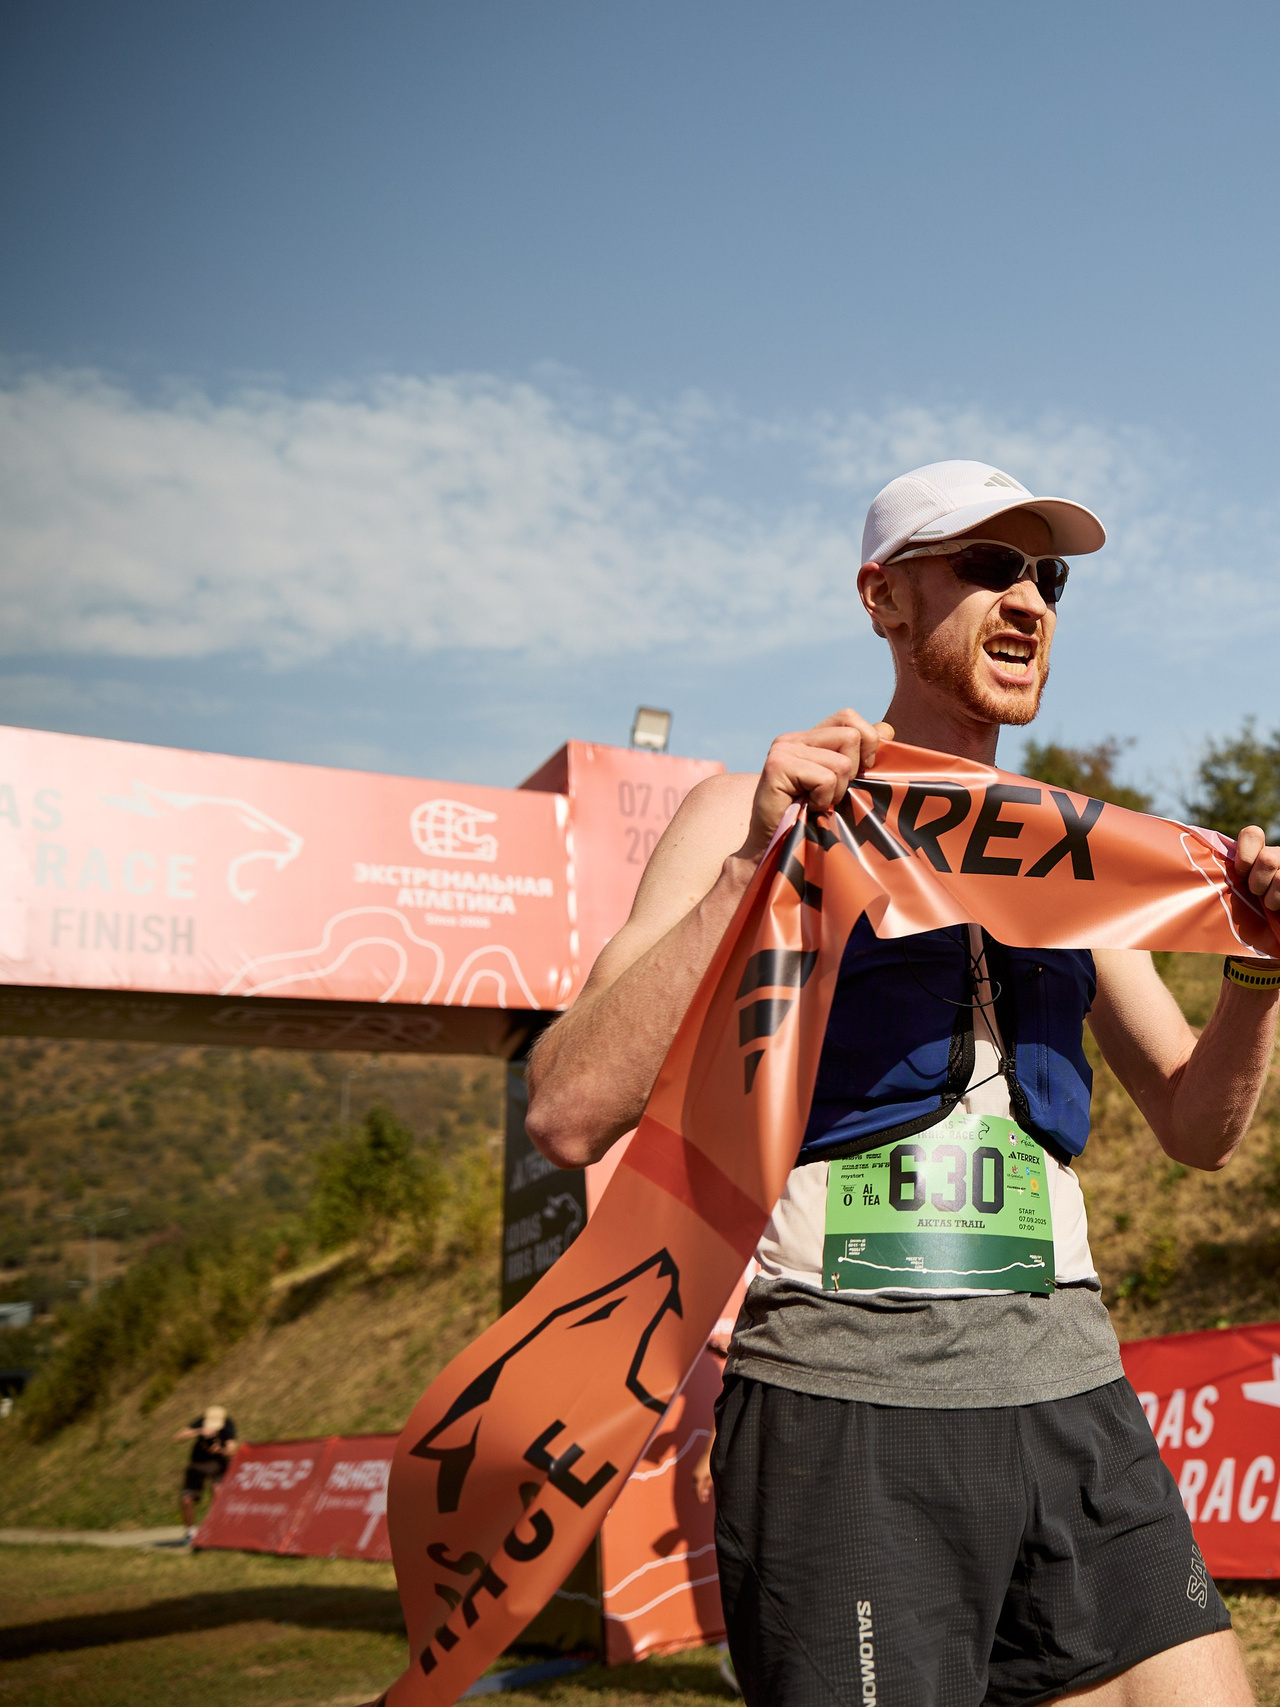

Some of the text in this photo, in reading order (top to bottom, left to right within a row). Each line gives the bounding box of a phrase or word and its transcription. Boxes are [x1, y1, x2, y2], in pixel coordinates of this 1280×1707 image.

[618, 780, 691, 821] 07.0
[34, 842, 198, 900] RACE
[354, 862, 554, 898] ЭКСТРЕМАЛЬНАЯ
[396, 887, 517, 915] АТЛЕТИКА
[51, 908, 195, 956] FINISH
[949, 1131, 974, 1140] RACE
[1016, 1151, 1040, 1165] TERREX
[863, 1184, 873, 1194] Ai
[889, 1144, 1004, 1214] 630
[862, 1195, 880, 1206] TEA
[917, 1218, 986, 1229] AKTAS TRAIL
[1018, 1216, 1047, 1225] 07.09.2025
